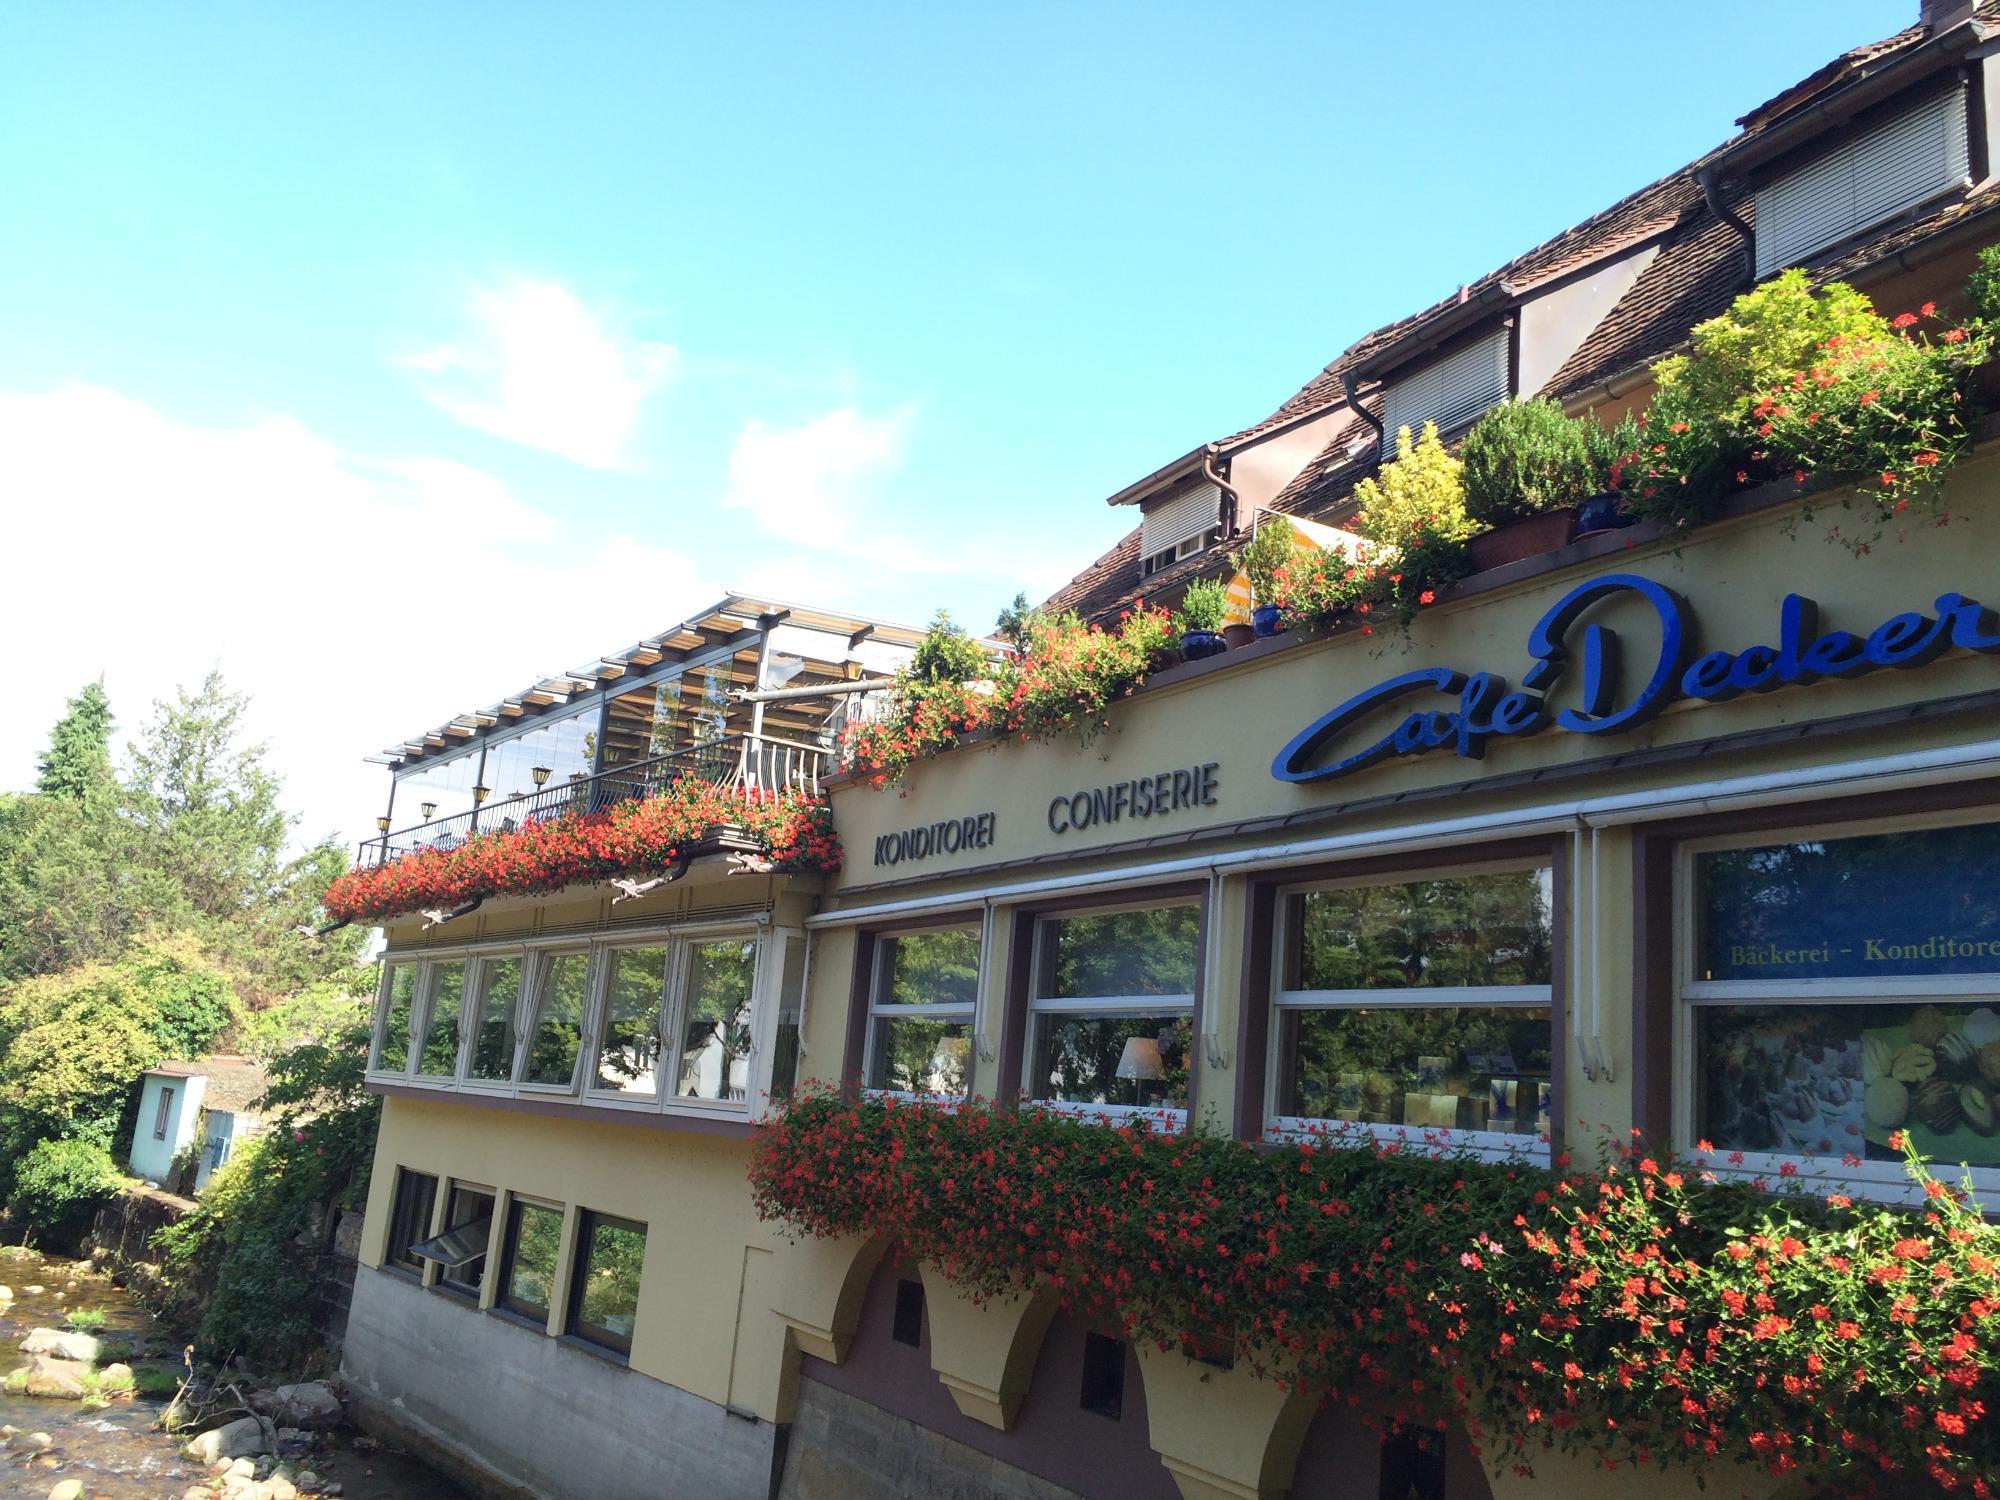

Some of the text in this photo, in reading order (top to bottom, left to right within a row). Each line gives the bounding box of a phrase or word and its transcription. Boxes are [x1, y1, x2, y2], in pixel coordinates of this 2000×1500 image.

[1527, 573, 2000, 735] Decker
[874, 762, 1221, 867] KONDITOREI CONFISERIE
[1731, 941, 1830, 966] Bäckerei
